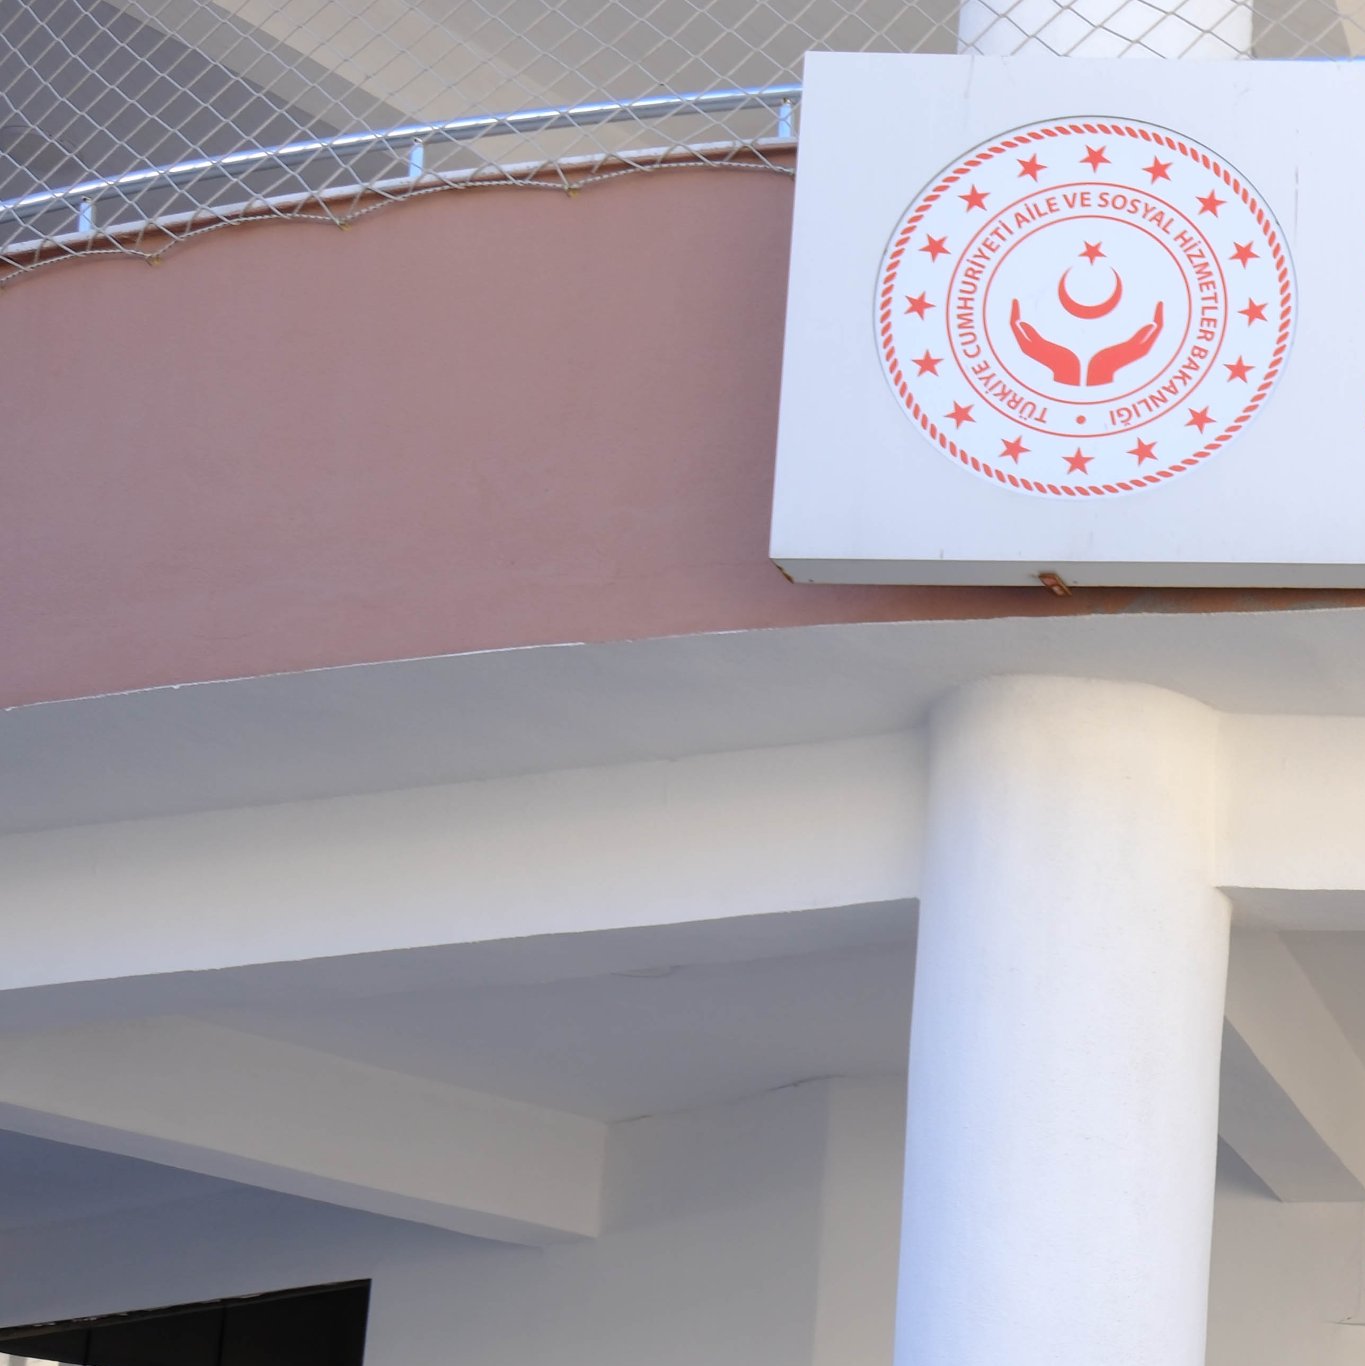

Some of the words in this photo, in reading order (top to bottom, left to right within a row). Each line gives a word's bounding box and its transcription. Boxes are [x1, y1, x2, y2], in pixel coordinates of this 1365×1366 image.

[1014, 196, 1060, 229] AİLE
[1063, 191, 1091, 209] VE
[1098, 191, 1175, 235] SOSYAL
[957, 219, 1014, 359] CUMHURİYETİ
[1173, 229, 1219, 342] HİZMETLER
[971, 360, 1048, 424] TÜRKİYE
[1109, 344, 1209, 426] BAKANLIĞI
